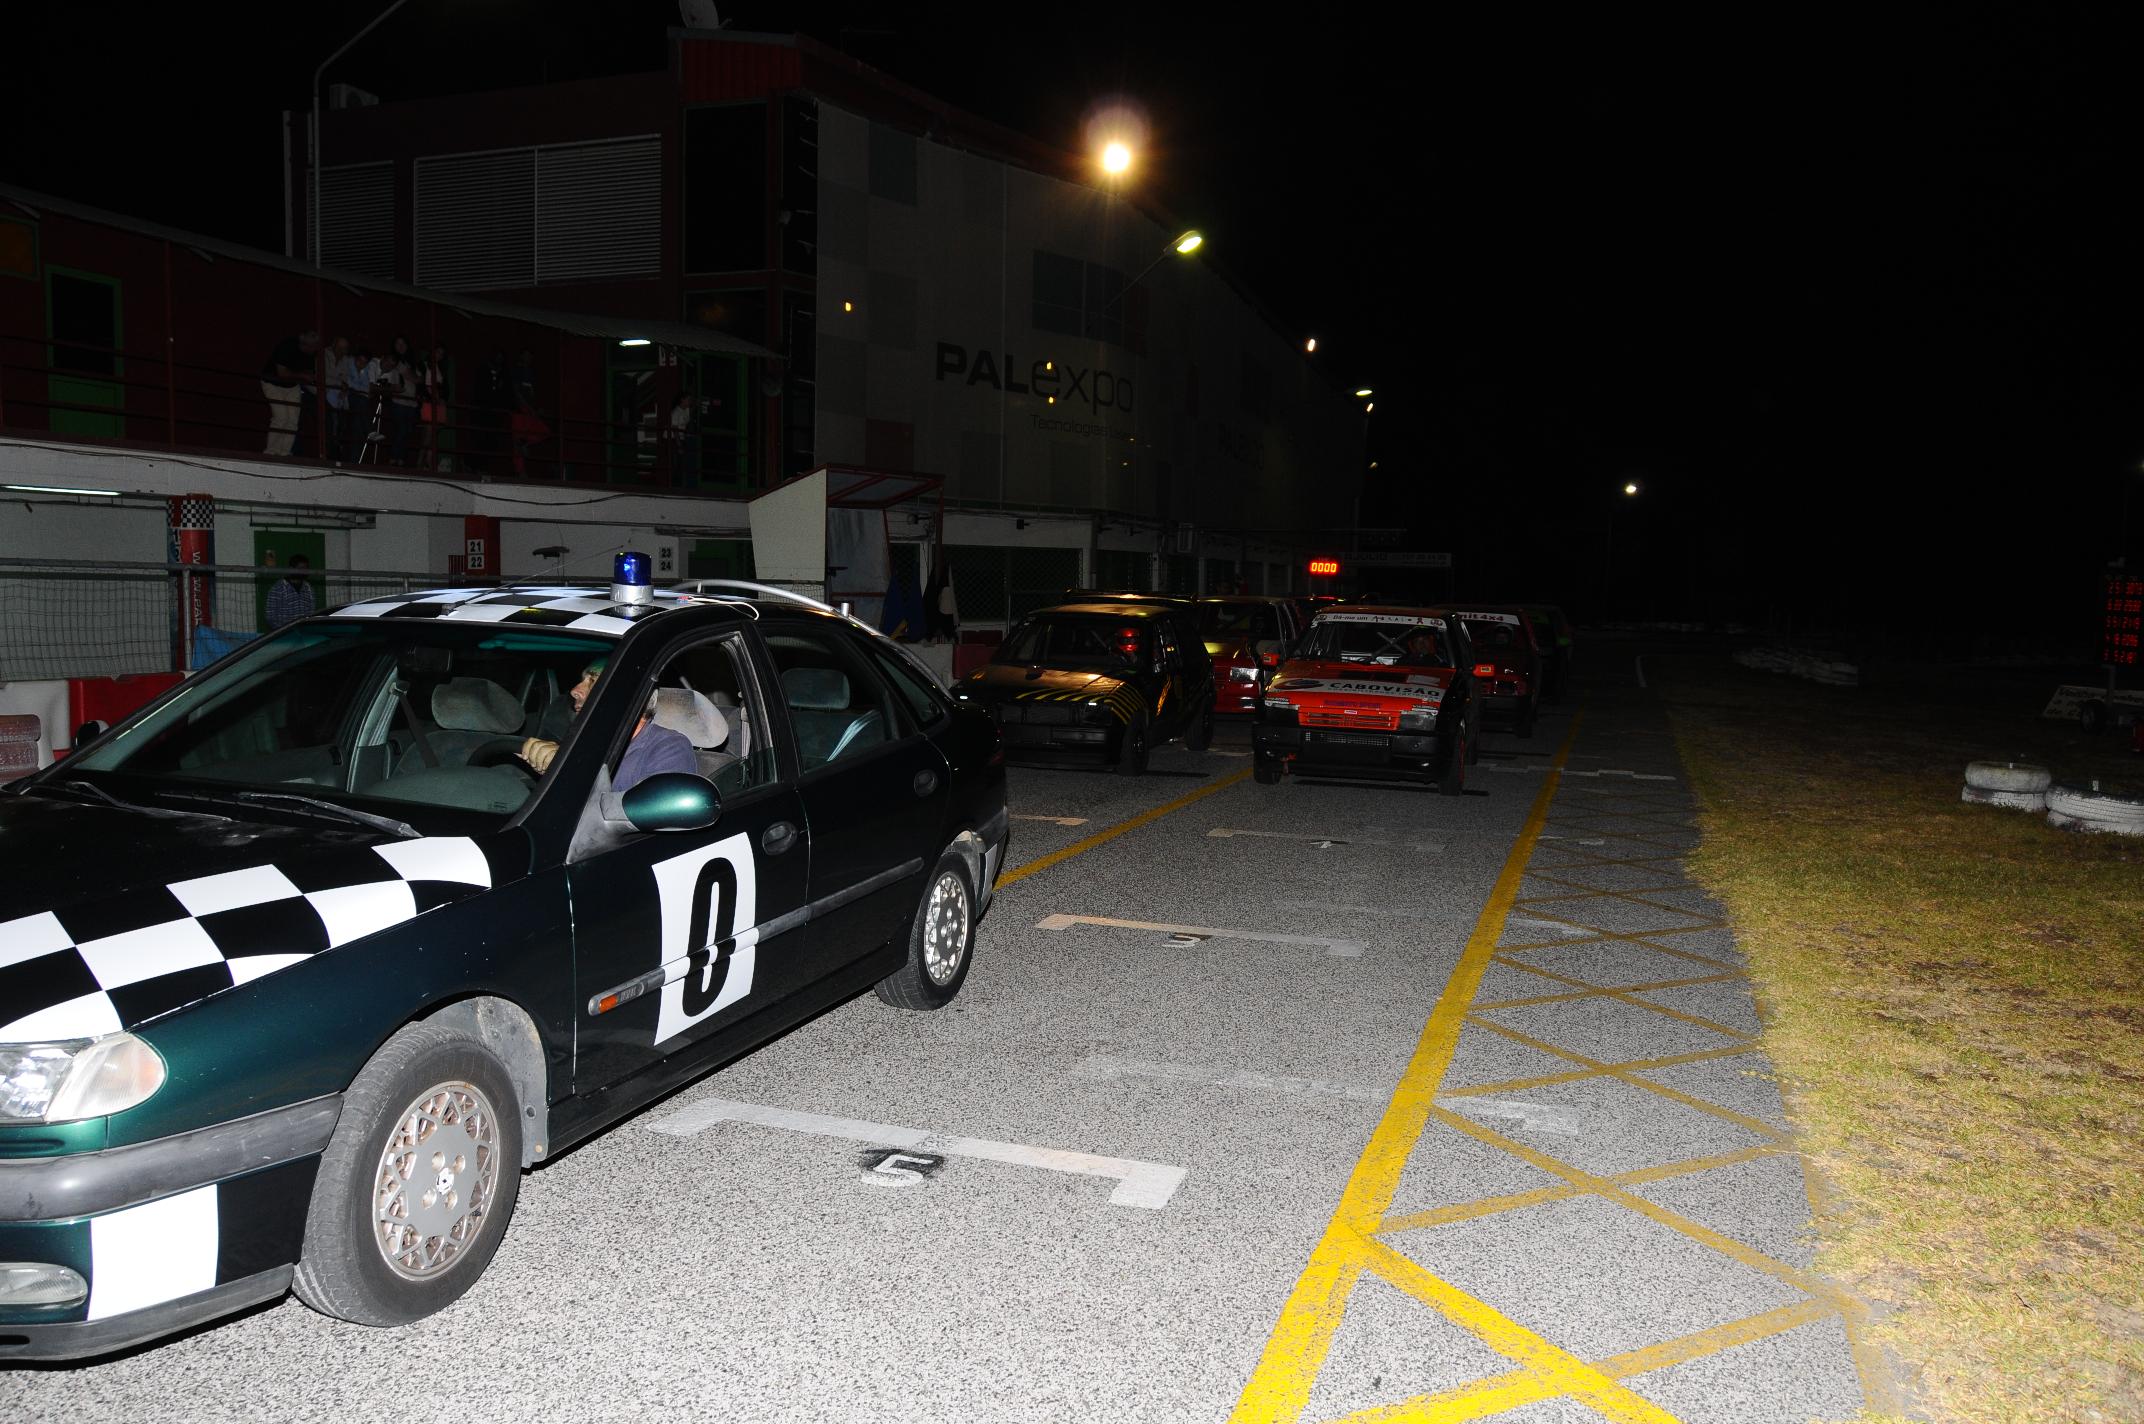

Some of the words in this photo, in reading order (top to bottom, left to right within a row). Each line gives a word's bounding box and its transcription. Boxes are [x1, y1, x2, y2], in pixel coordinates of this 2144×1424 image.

[936, 341, 1134, 416] PALexpo
[470, 541, 481, 552] 21
[471, 556, 482, 567] 22
[1311, 562, 1337, 573] 0000
[682, 857, 738, 1018] 0
[860, 1152, 934, 1187] 5
